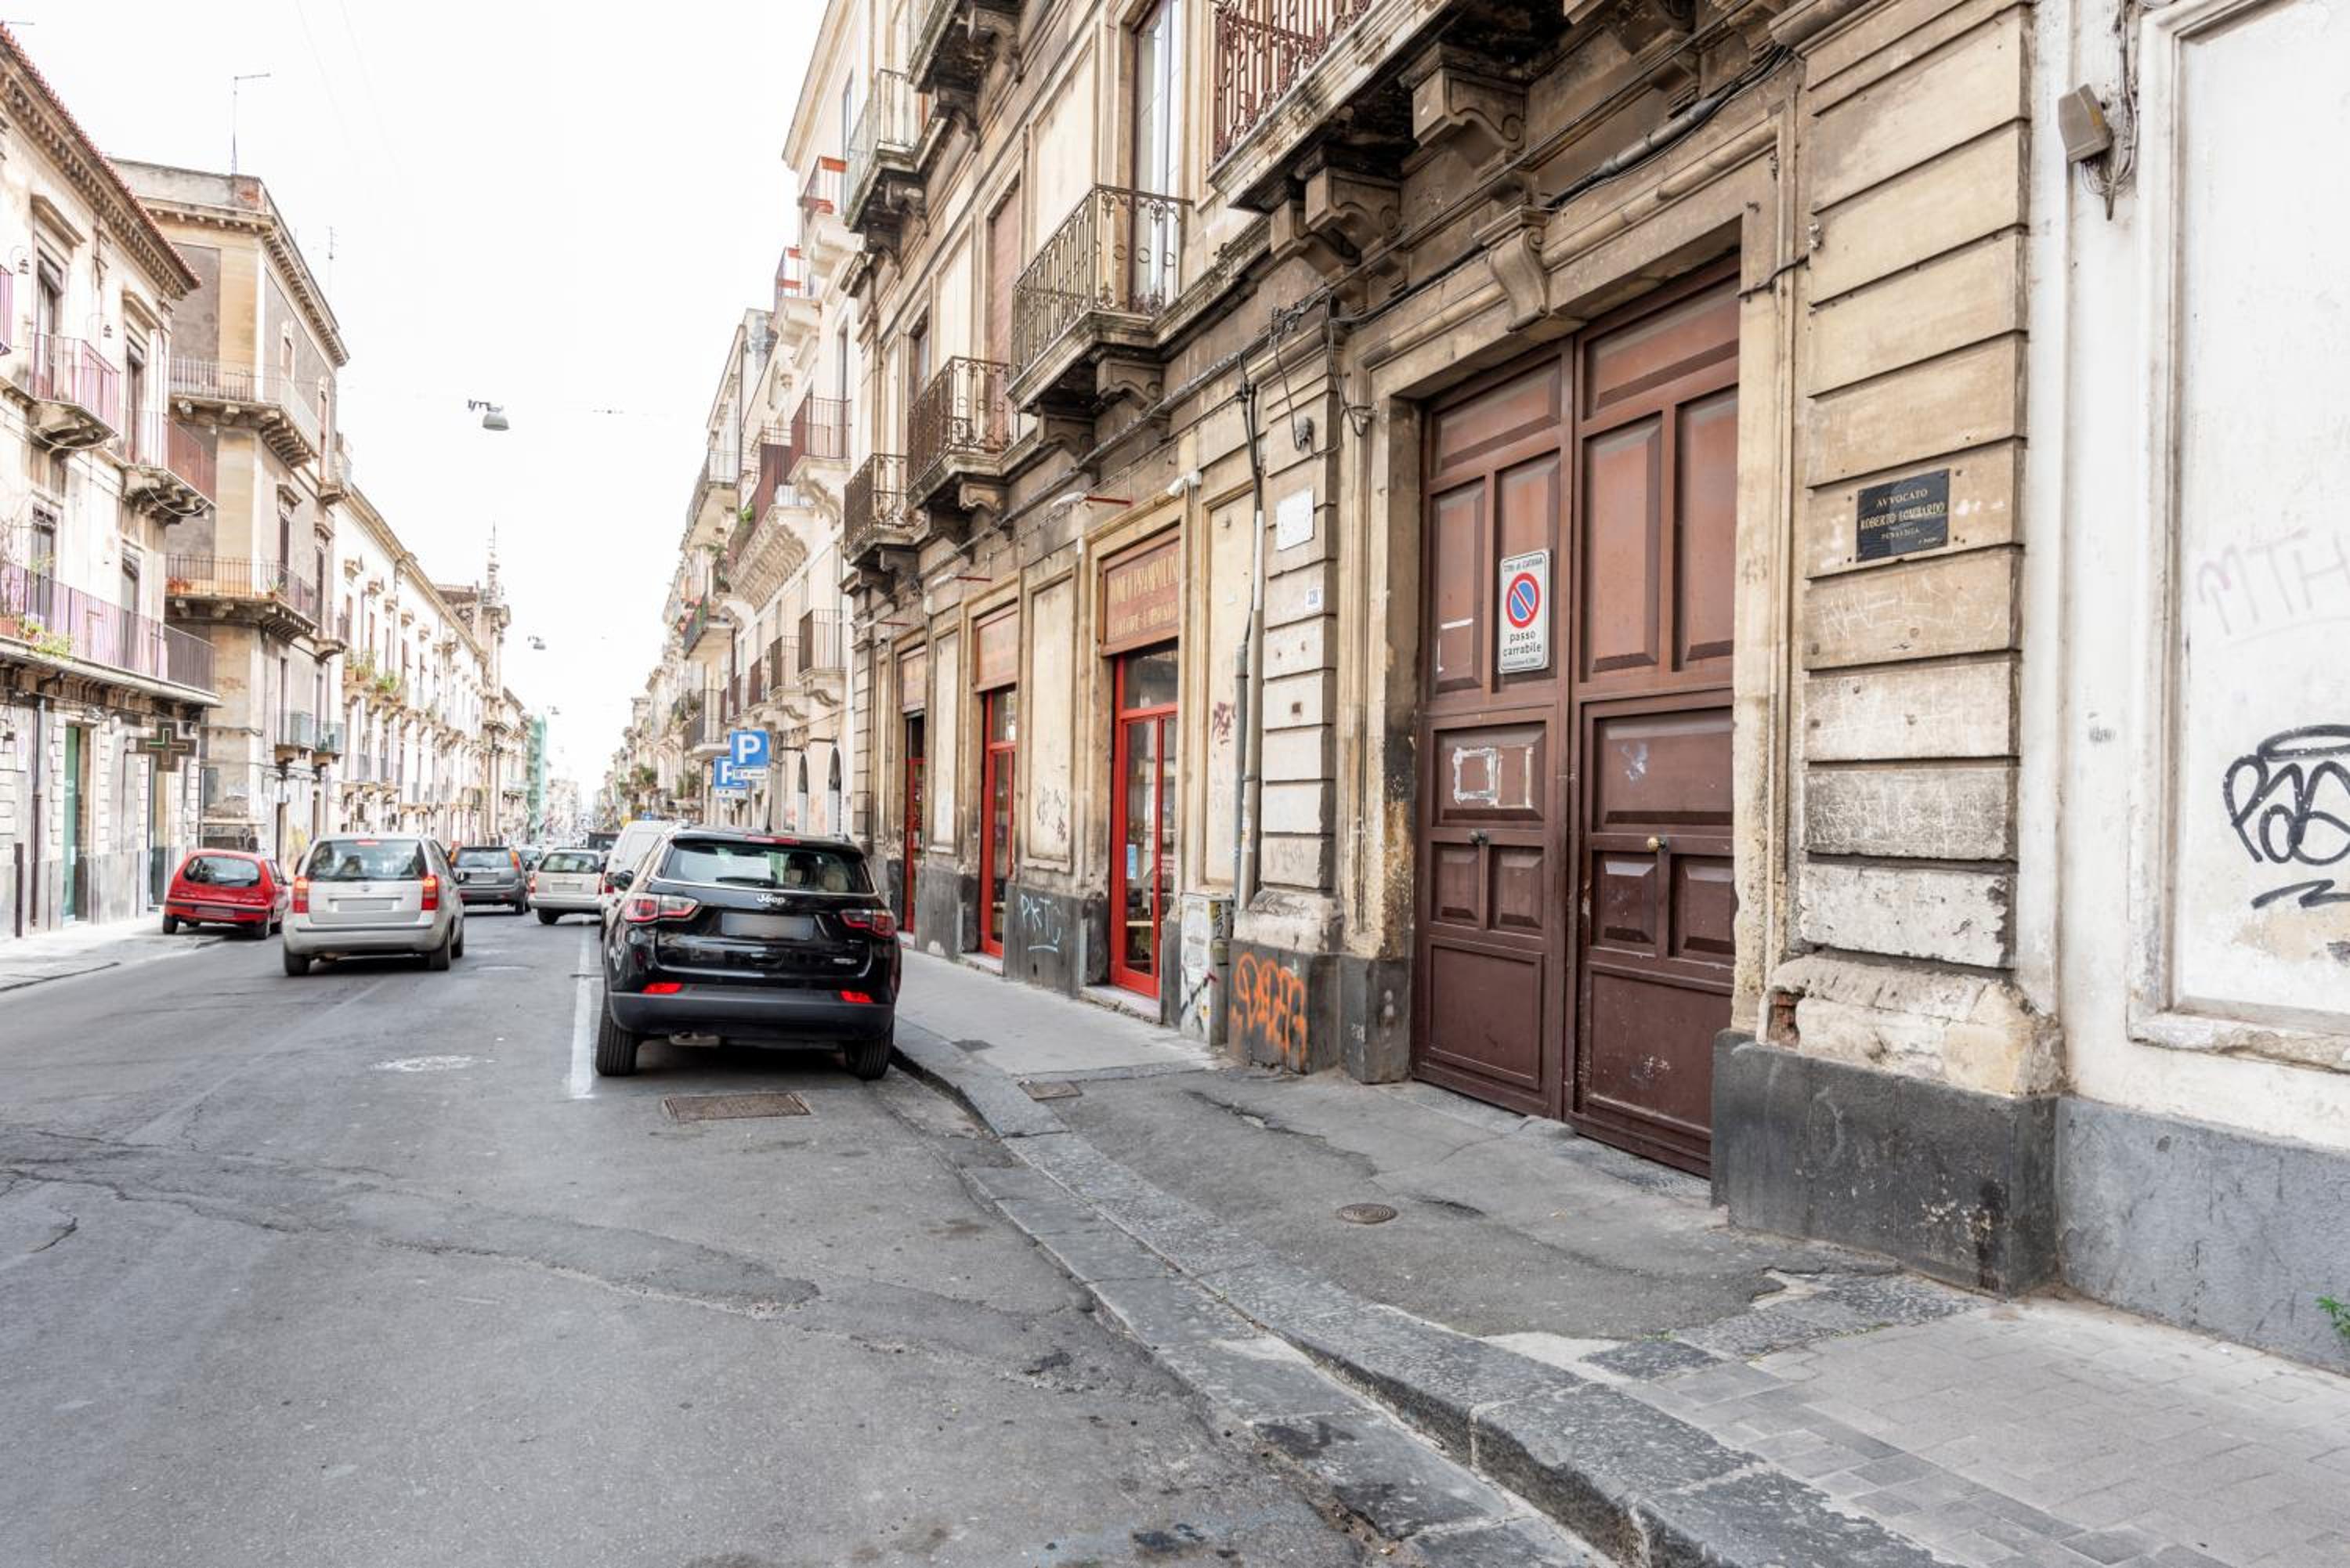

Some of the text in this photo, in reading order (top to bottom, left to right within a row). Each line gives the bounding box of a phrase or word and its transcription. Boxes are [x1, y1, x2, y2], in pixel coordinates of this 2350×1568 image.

[1877, 488, 1928, 508] AVVOCATO
[1509, 630, 1535, 645] passo
[1503, 641, 1542, 657] carrabile
[739, 734, 761, 764] P
[757, 893, 786, 904] Jeep
